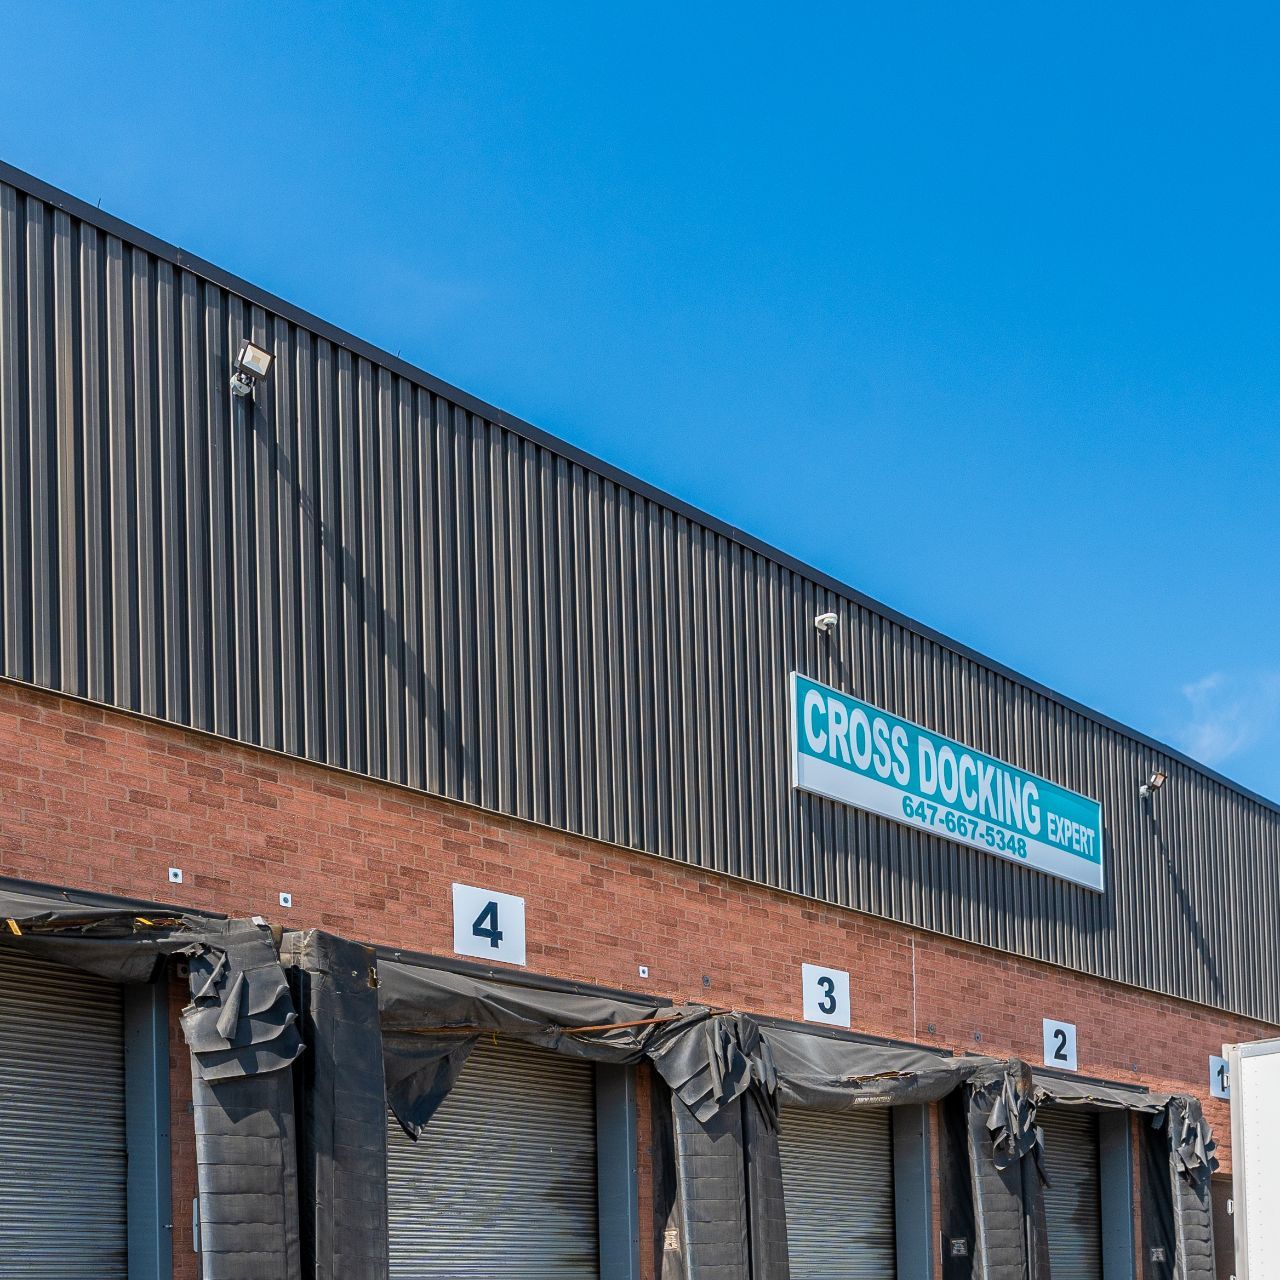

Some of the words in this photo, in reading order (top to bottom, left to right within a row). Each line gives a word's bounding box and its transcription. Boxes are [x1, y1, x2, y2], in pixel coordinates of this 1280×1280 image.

[803, 688, 911, 786] CROSS
[918, 735, 1041, 835] DOCKING
[1047, 811, 1095, 857] EXPERT
[901, 795, 1028, 859] 647-667-5348
[472, 900, 504, 949] 4
[816, 976, 837, 1015] 3
[1053, 1028, 1068, 1062] 2
[1216, 1064, 1226, 1093] 1
